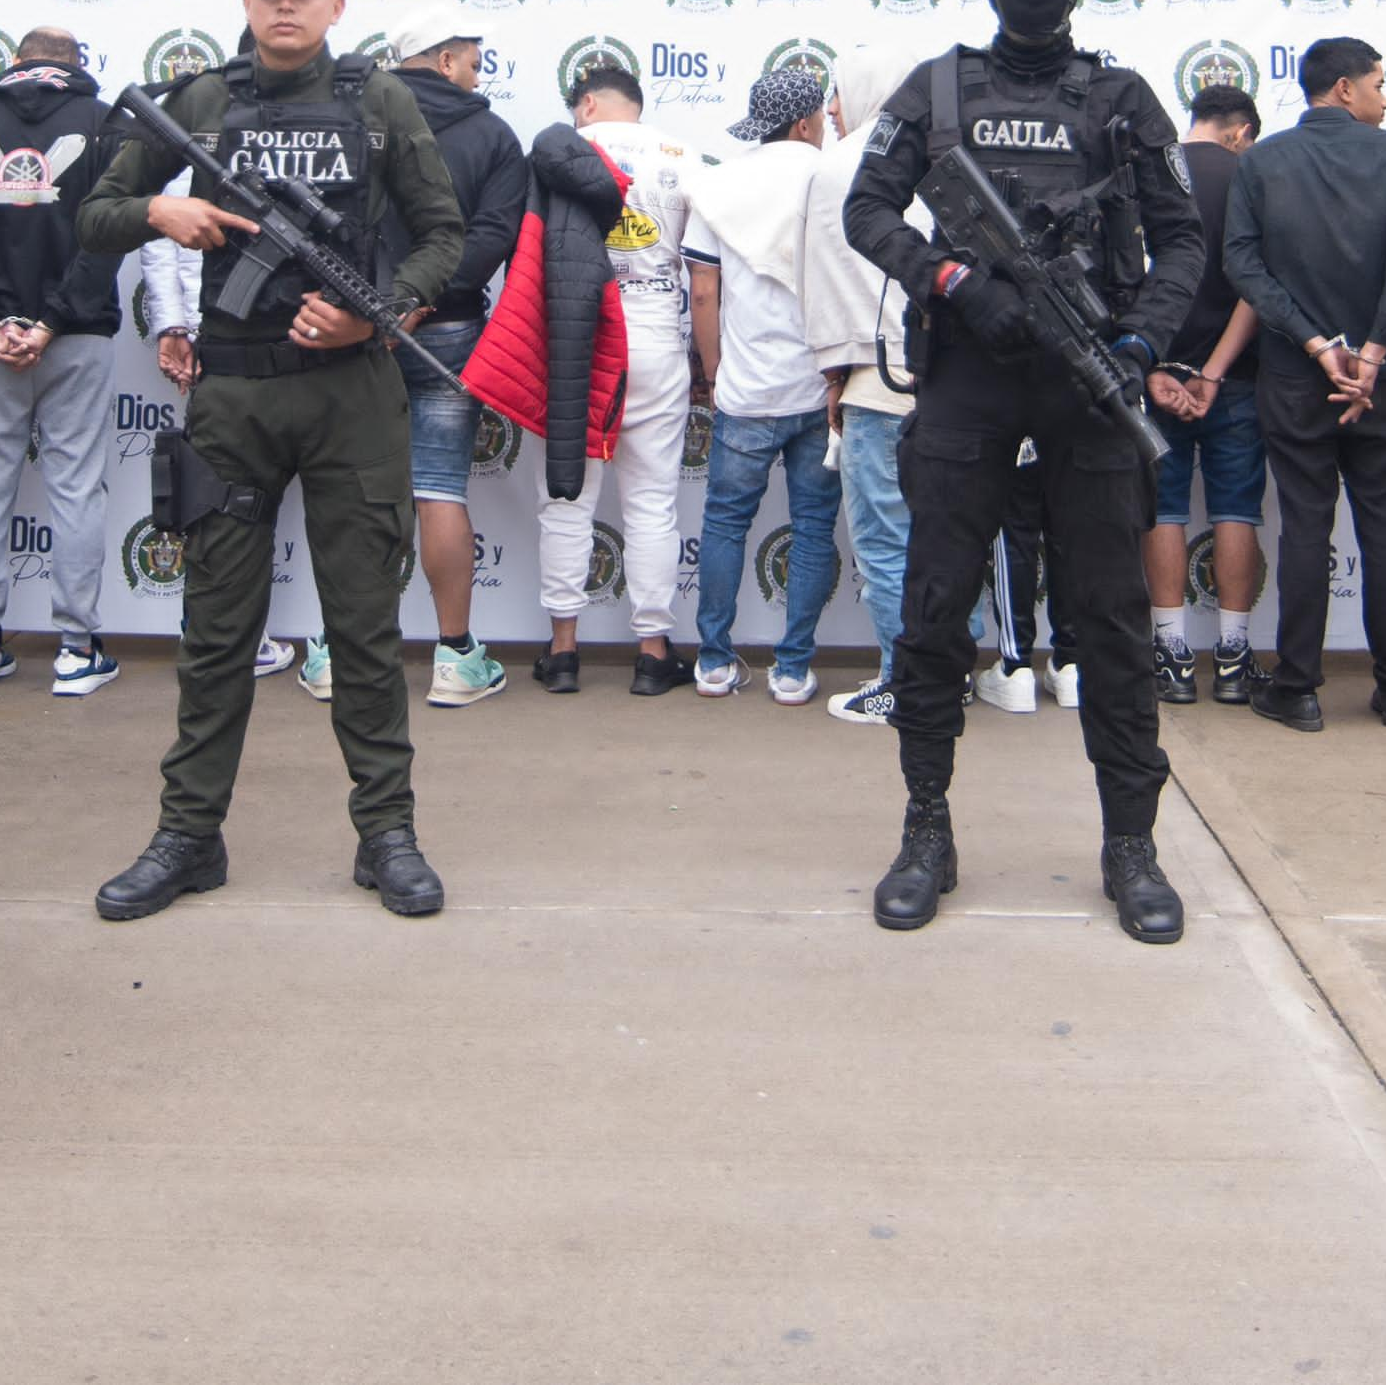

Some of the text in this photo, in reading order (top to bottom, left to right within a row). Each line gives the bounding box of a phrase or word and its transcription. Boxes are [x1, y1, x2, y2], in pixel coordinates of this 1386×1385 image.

[98, 55, 107, 72] y
[507, 61, 515, 79] y
[652, 43, 725, 82] Dios y
[651, 75, 725, 109] Patria
[241, 130, 343, 148] POLICIA
[971, 119, 1072, 151] GAULA
[231, 149, 353, 182] GAULA
[118, 394, 175, 430] Dios
[10, 516, 52, 553] Dio
[285, 542, 294, 562] y
[494, 546, 503, 565] y
[1347, 557, 1356, 576] y
[864, 692, 895, 714] D&G
